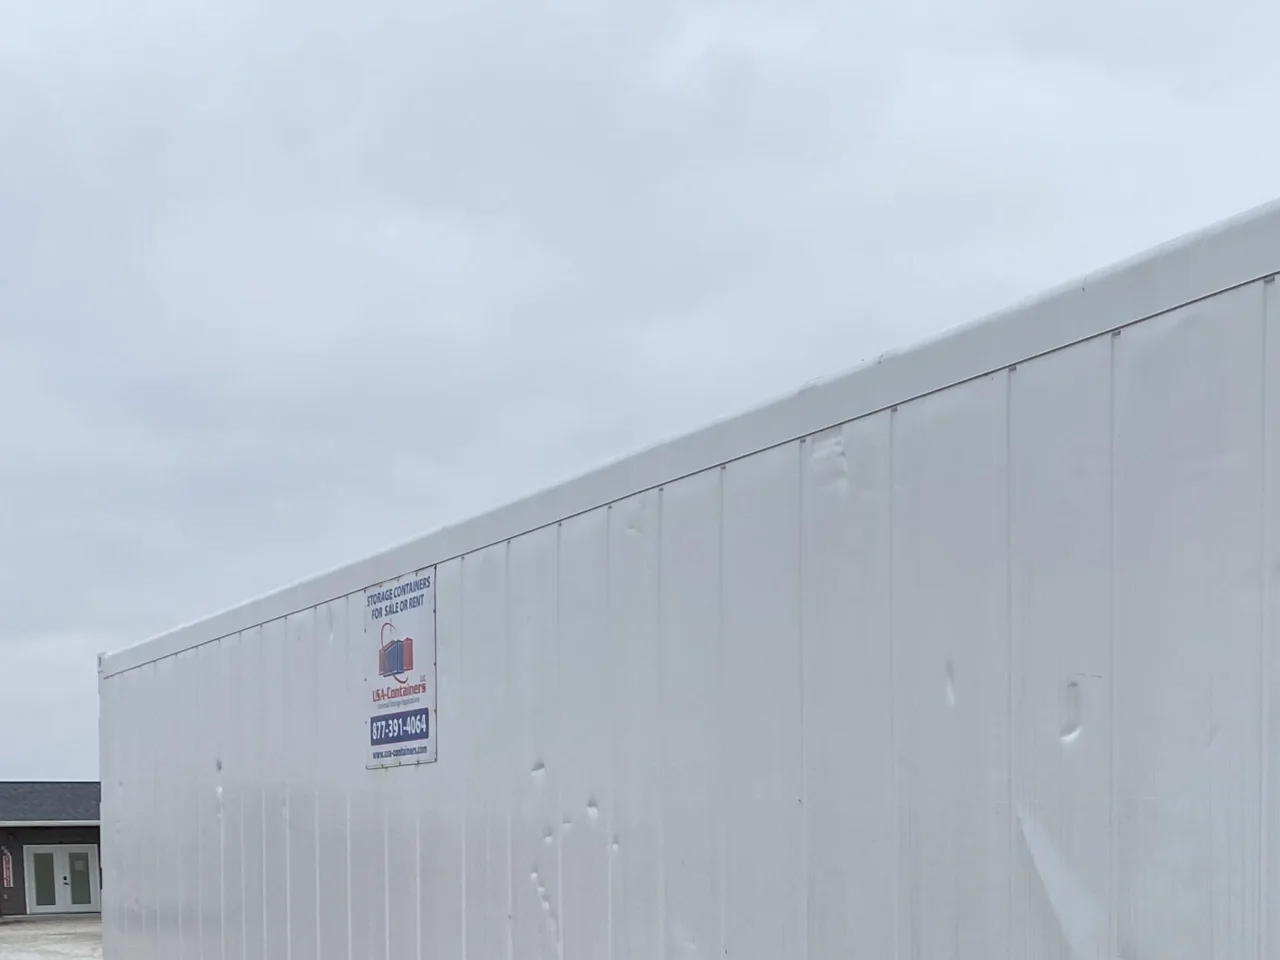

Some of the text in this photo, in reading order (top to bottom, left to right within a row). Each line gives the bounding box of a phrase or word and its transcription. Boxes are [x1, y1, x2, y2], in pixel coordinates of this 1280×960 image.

[366, 575, 431, 607] STORAGE CONTAINERS
[371, 593, 424, 620] FOR SALE OR RENT
[372, 683, 426, 702] USA-Containers
[372, 714, 427, 740] 877-391-4064
